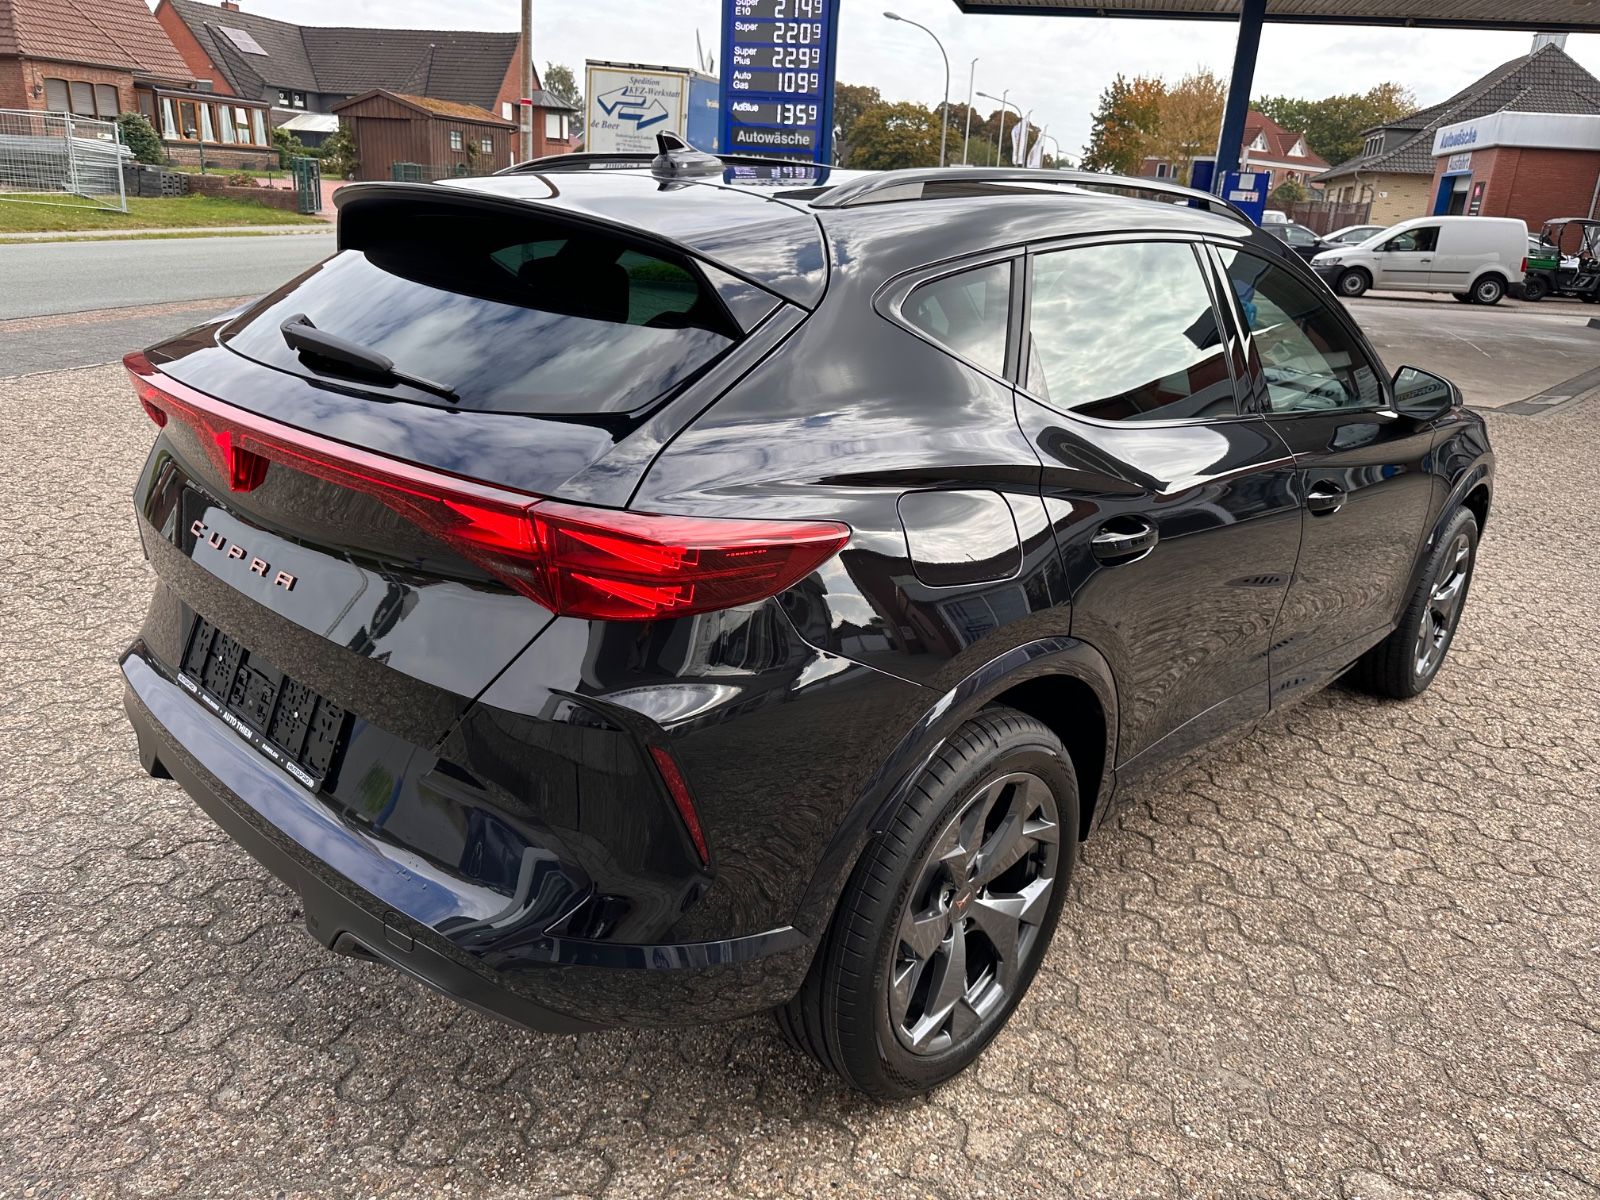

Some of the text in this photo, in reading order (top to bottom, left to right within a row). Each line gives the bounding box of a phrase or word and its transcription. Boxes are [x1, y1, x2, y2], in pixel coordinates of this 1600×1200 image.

[735, 7, 751, 16] E10
[735, 21, 758, 32] Super
[734, 46, 757, 57] Super
[733, 56, 751, 65] Plus
[733, 70, 752, 80] Auto
[628, 76, 660, 87] Spedition
[732, 80, 749, 90] Gas
[628, 87, 681, 98] KFZ-Werkstatt
[732, 101, 759, 112] AdBlue
[590, 119, 620, 130] de Boer
[737, 130, 810, 145] Autowäsche
[1439, 127, 1477, 150] Autowäsche
[190, 519, 299, 592] CUPRA
[725, 549, 767, 557] FORMENTOR
[222, 711, 253, 740] AUTO THIEN
